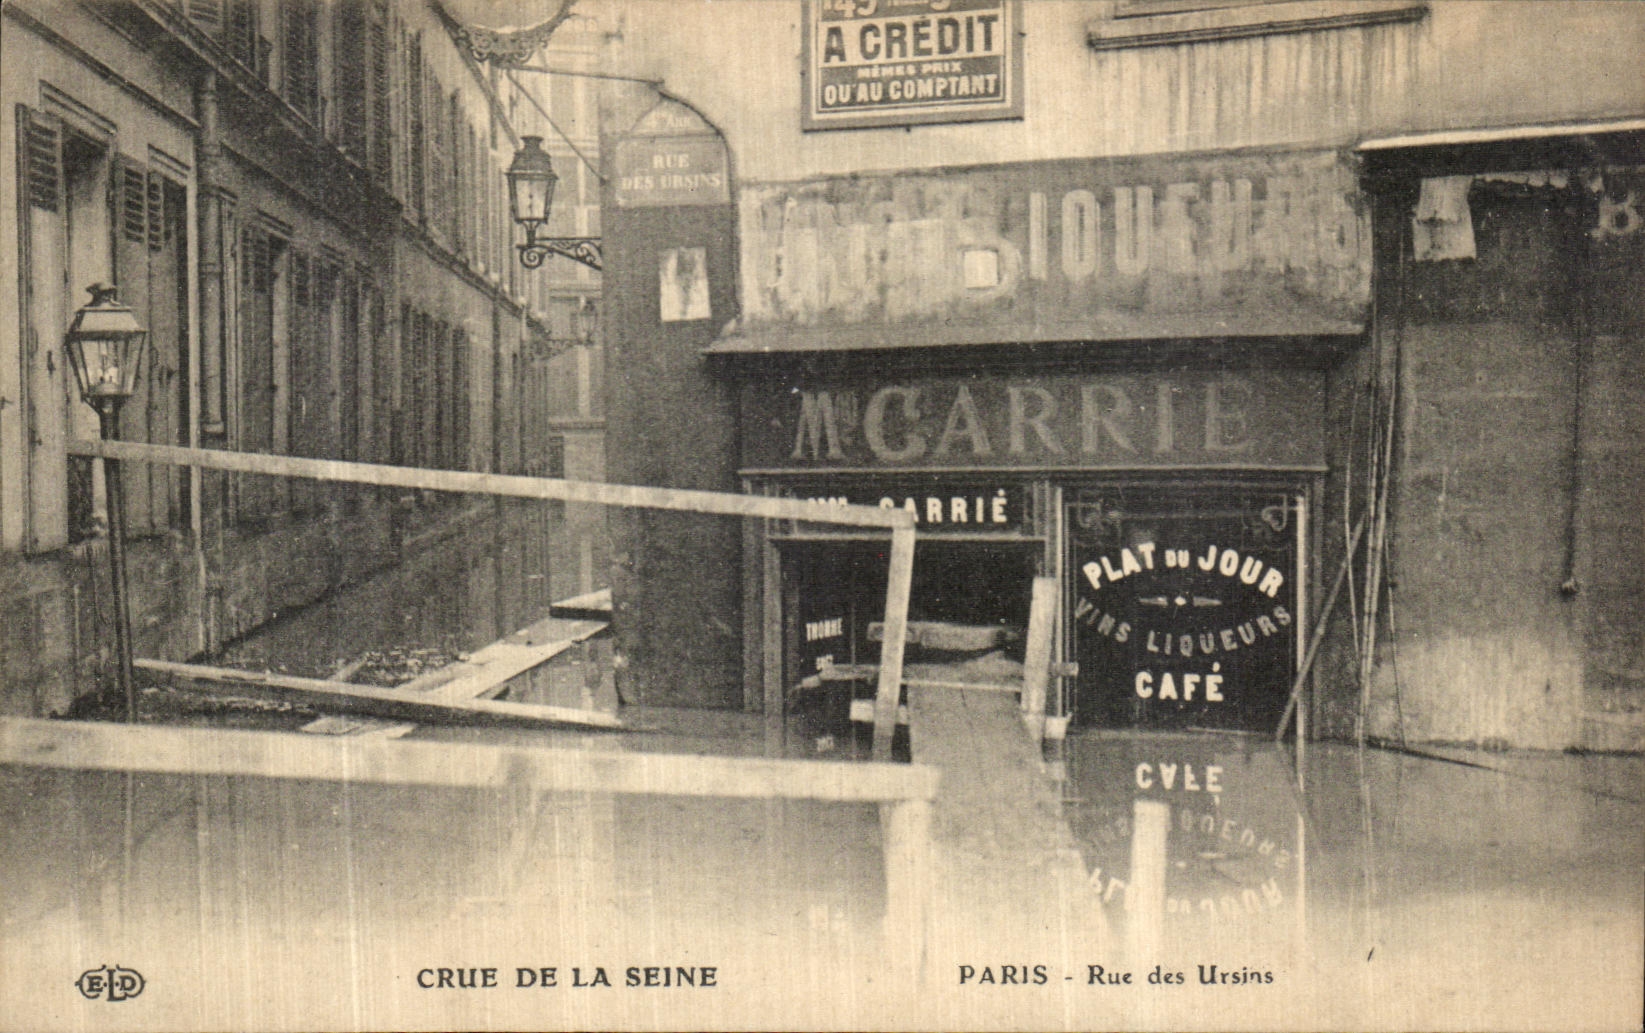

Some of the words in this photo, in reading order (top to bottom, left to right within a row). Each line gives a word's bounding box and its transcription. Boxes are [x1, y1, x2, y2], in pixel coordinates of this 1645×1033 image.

[824, 26, 846, 63] A
[921, 61, 962, 74] PRIX
[888, 74, 998, 99] COMPTANT
[652, 154, 690, 168] RUE
[621, 175, 654, 190] DES
[660, 173, 721, 189] URSINS
[1083, 542, 1156, 590] PLAT
[1165, 549, 1190, 568] DU
[1198, 545, 1284, 598] JOUR
[1075, 597, 1131, 642] VINS
[1146, 606, 1291, 657] LIQUEURS
[1135, 661, 1224, 701] CAFÉ
